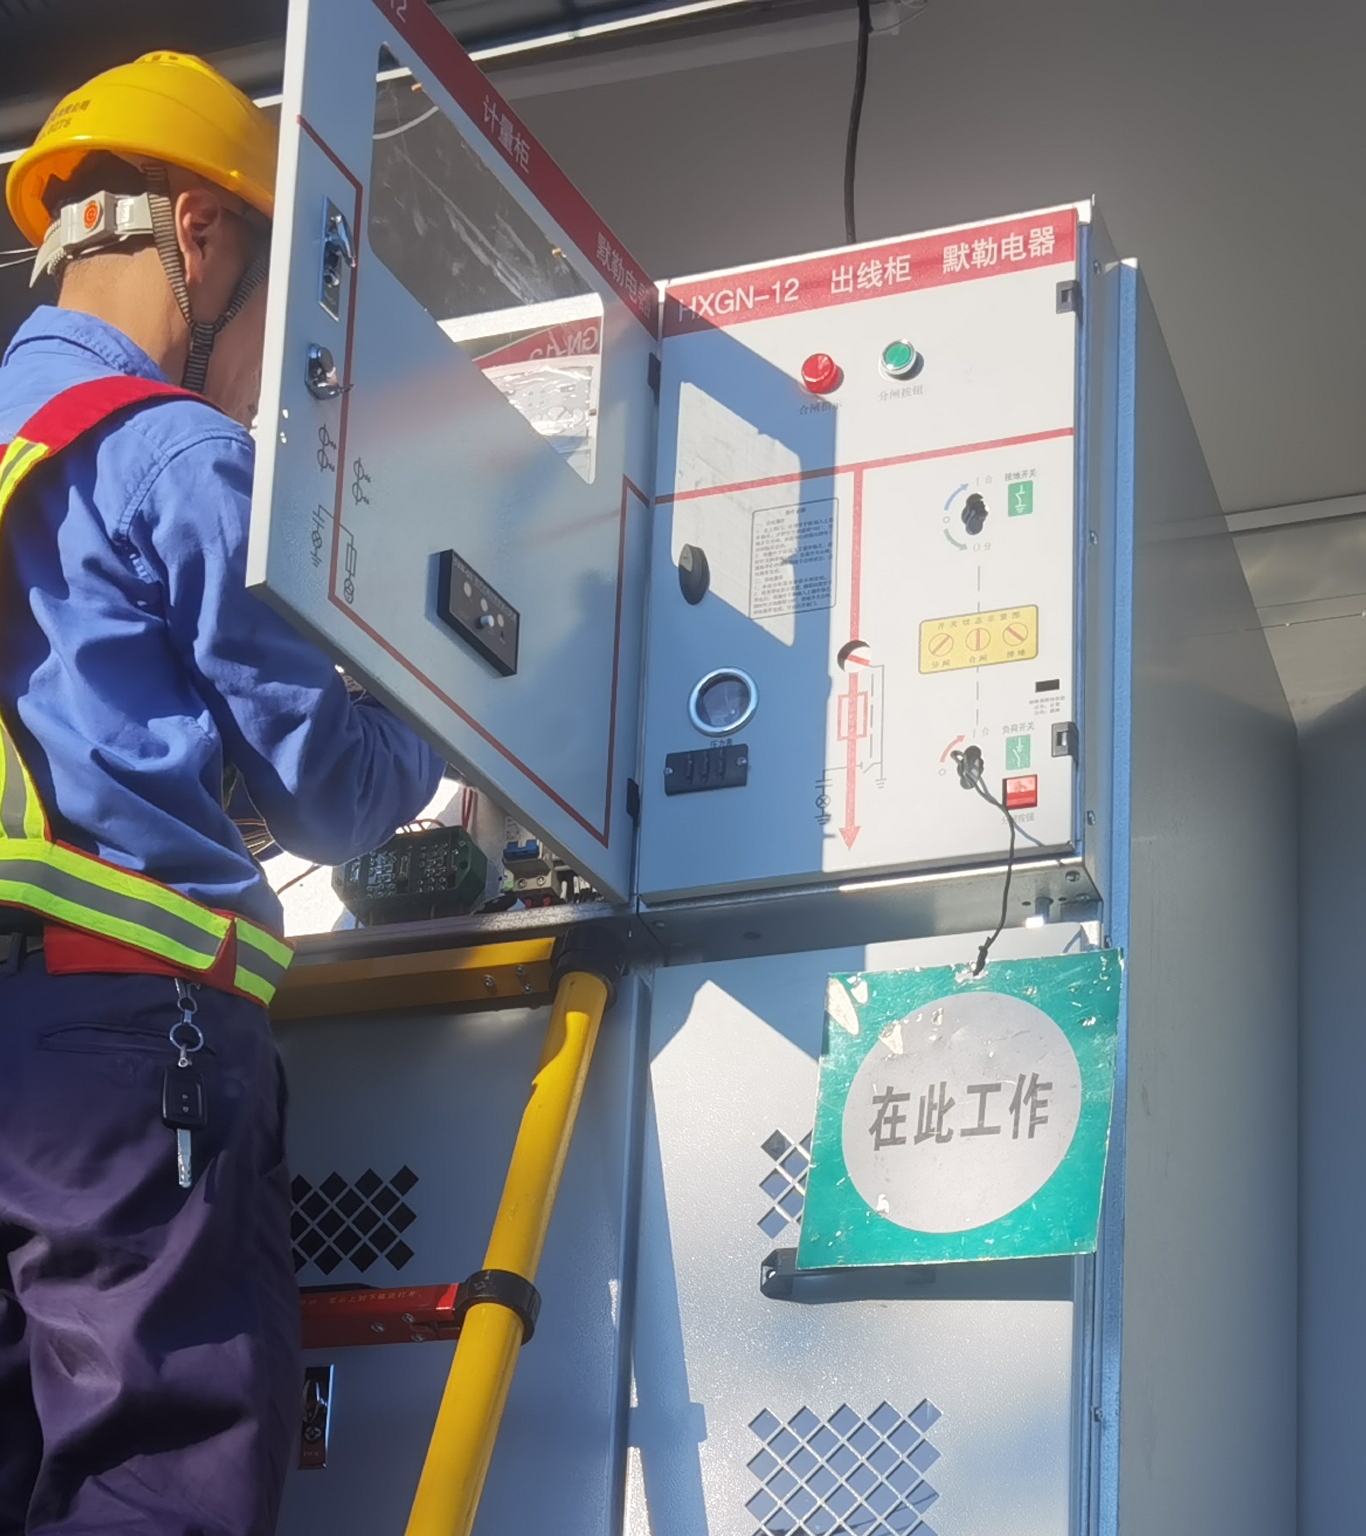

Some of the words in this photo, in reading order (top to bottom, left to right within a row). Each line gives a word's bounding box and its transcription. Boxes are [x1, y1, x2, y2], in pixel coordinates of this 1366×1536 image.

[483, 95, 530, 174] 计量柜
[678, 278, 800, 322] HXGN-12
[830, 254, 912, 295] 出线柜
[942, 225, 1056, 274] 默勒电器
[868, 1072, 1053, 1151] 在此工作
